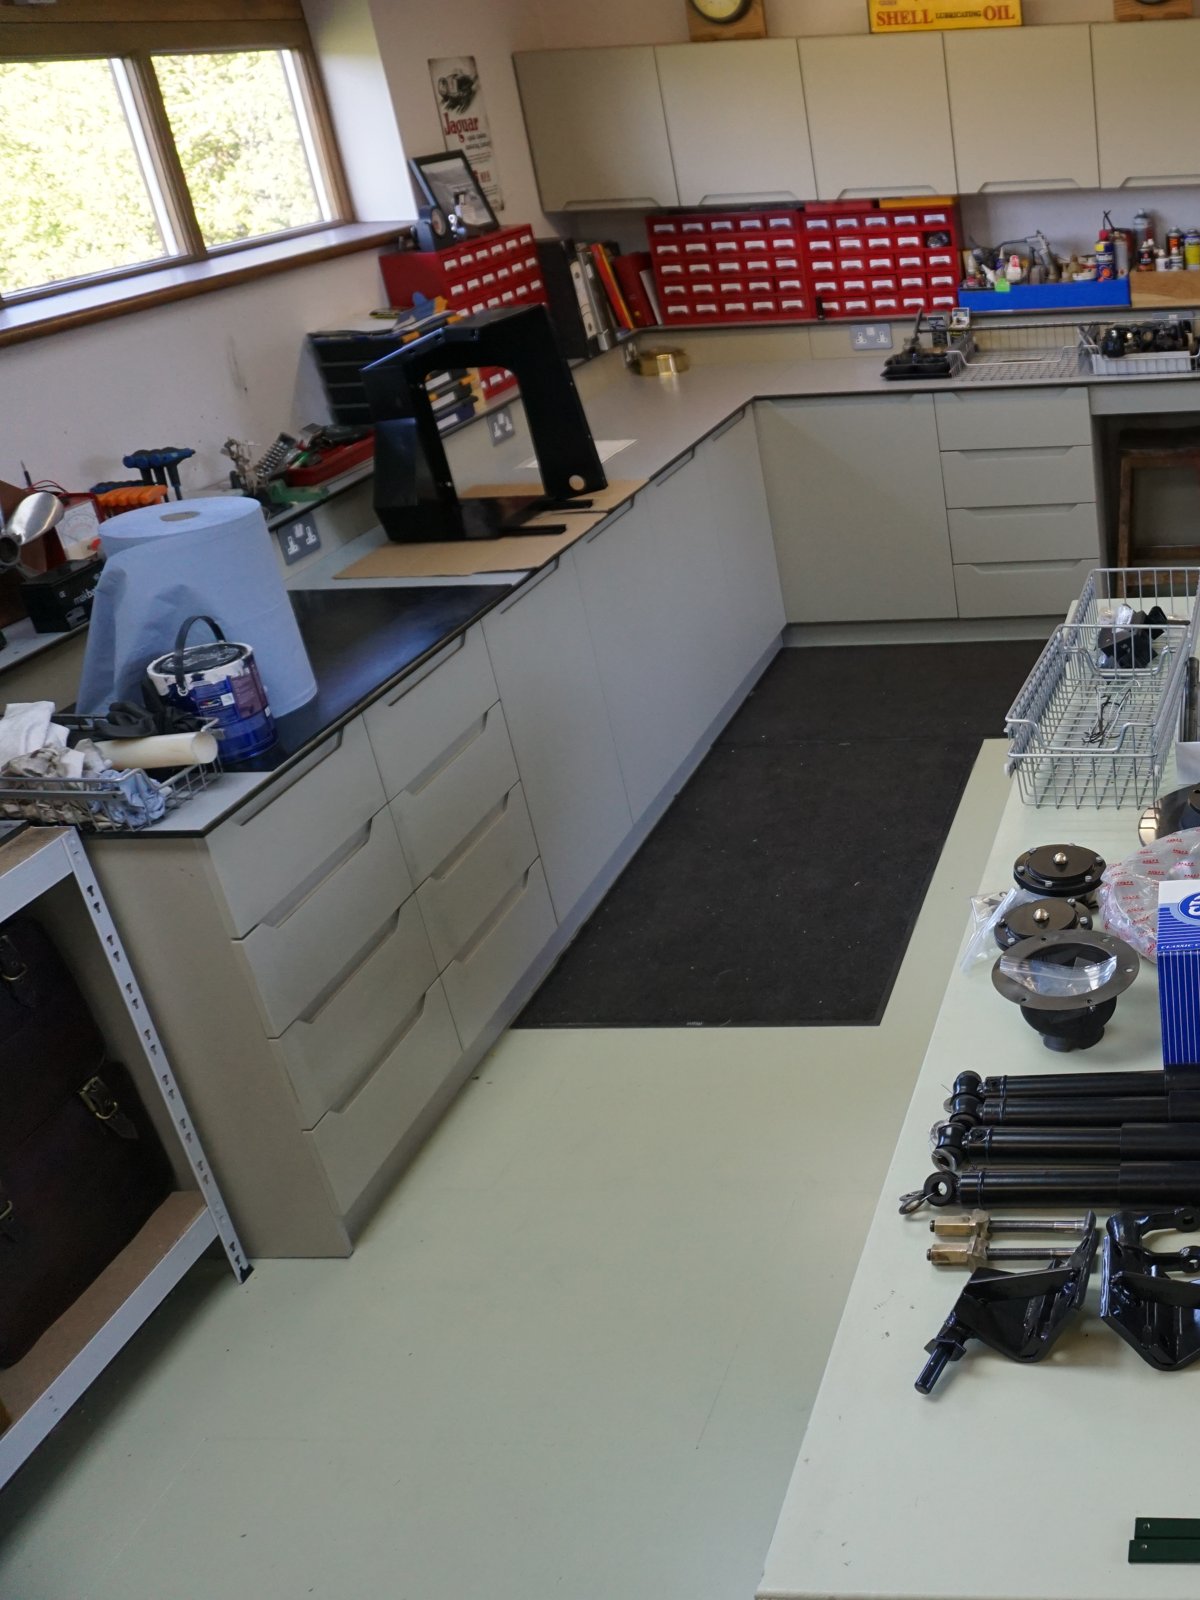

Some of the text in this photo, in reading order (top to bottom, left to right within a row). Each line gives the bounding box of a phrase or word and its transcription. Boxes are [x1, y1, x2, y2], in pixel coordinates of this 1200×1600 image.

[876, 5, 1015, 26] SHELL LUBRICATING OIL
[444, 112, 478, 142] Jaguar
